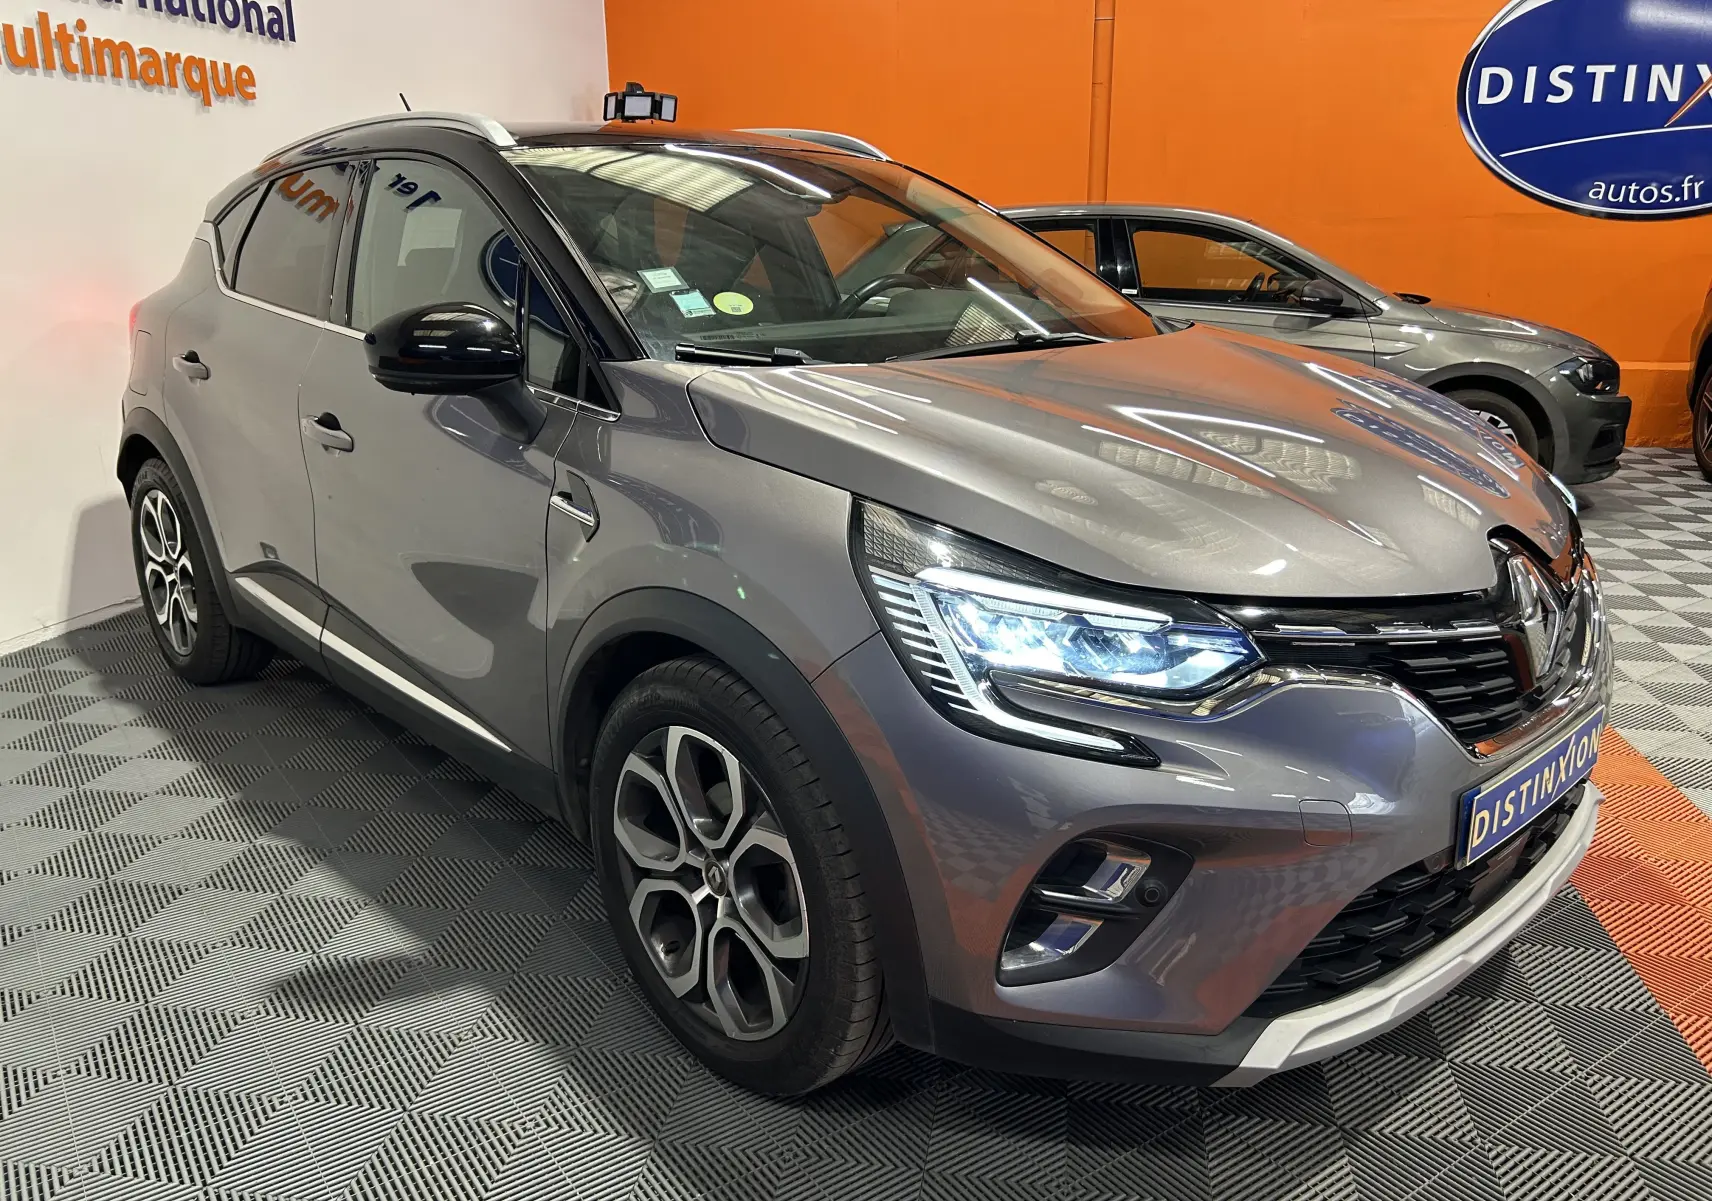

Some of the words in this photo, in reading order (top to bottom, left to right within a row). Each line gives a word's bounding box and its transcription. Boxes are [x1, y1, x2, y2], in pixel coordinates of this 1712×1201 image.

[138, 0, 296, 42] onal
[0, 11, 257, 107] ultimarque
[1588, 174, 1704, 204] autos.fr
[1472, 723, 1601, 848] DISTINXION
